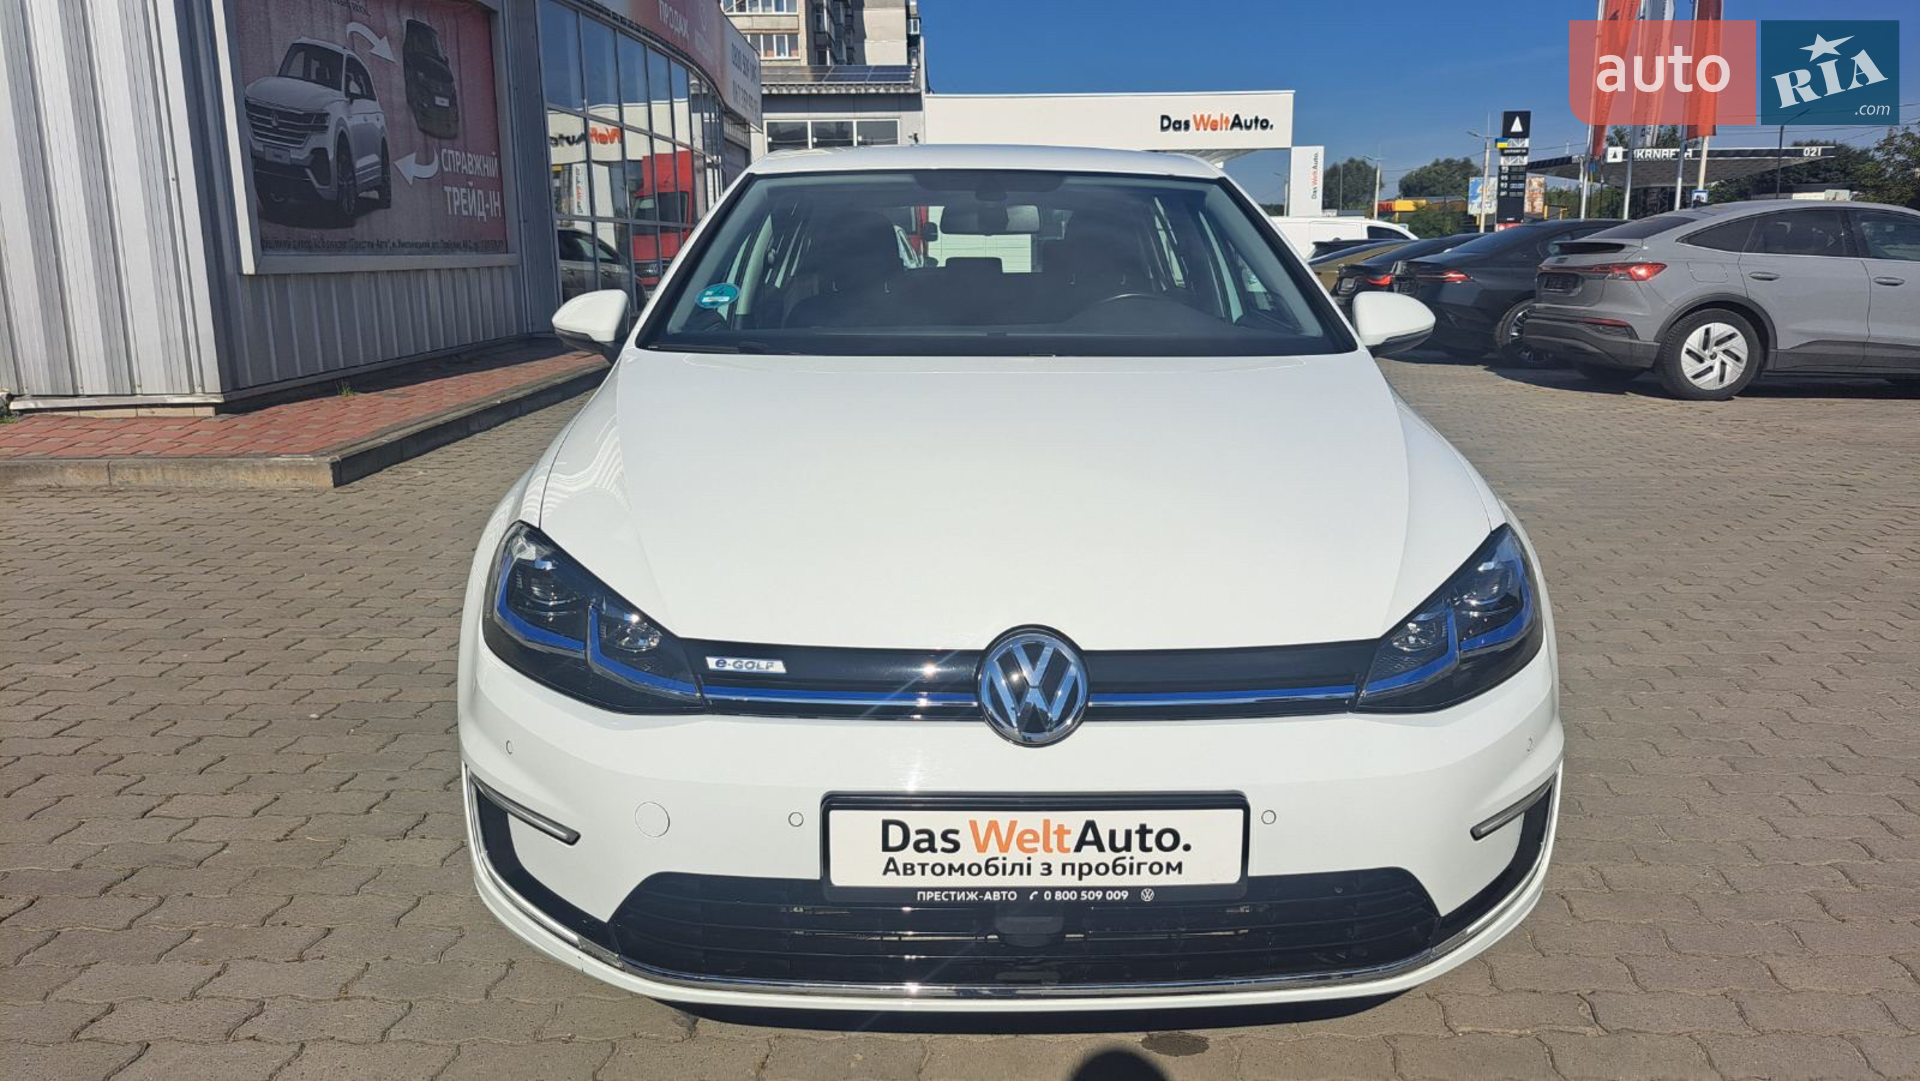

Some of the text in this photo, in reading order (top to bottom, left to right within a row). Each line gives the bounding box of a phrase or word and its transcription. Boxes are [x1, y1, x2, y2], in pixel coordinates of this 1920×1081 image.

[1160, 114, 1191, 132] Das
[441, 148, 499, 178] СПРАВЖНІЙ
[443, 181, 502, 221] ТРЕЙД-ІН
[715, 659, 774, 670] e-GOLF
[881, 818, 961, 853] Das
[882, 856, 1183, 881] Автомобілі з пробігом
[917, 890, 1018, 901] ПРЕСТИЖ-АВТО
[1044, 890, 1052, 901] 0
[1054, 890, 1077, 901] 800
[1080, 890, 1103, 901] 509
[1105, 890, 1129, 901] 009
